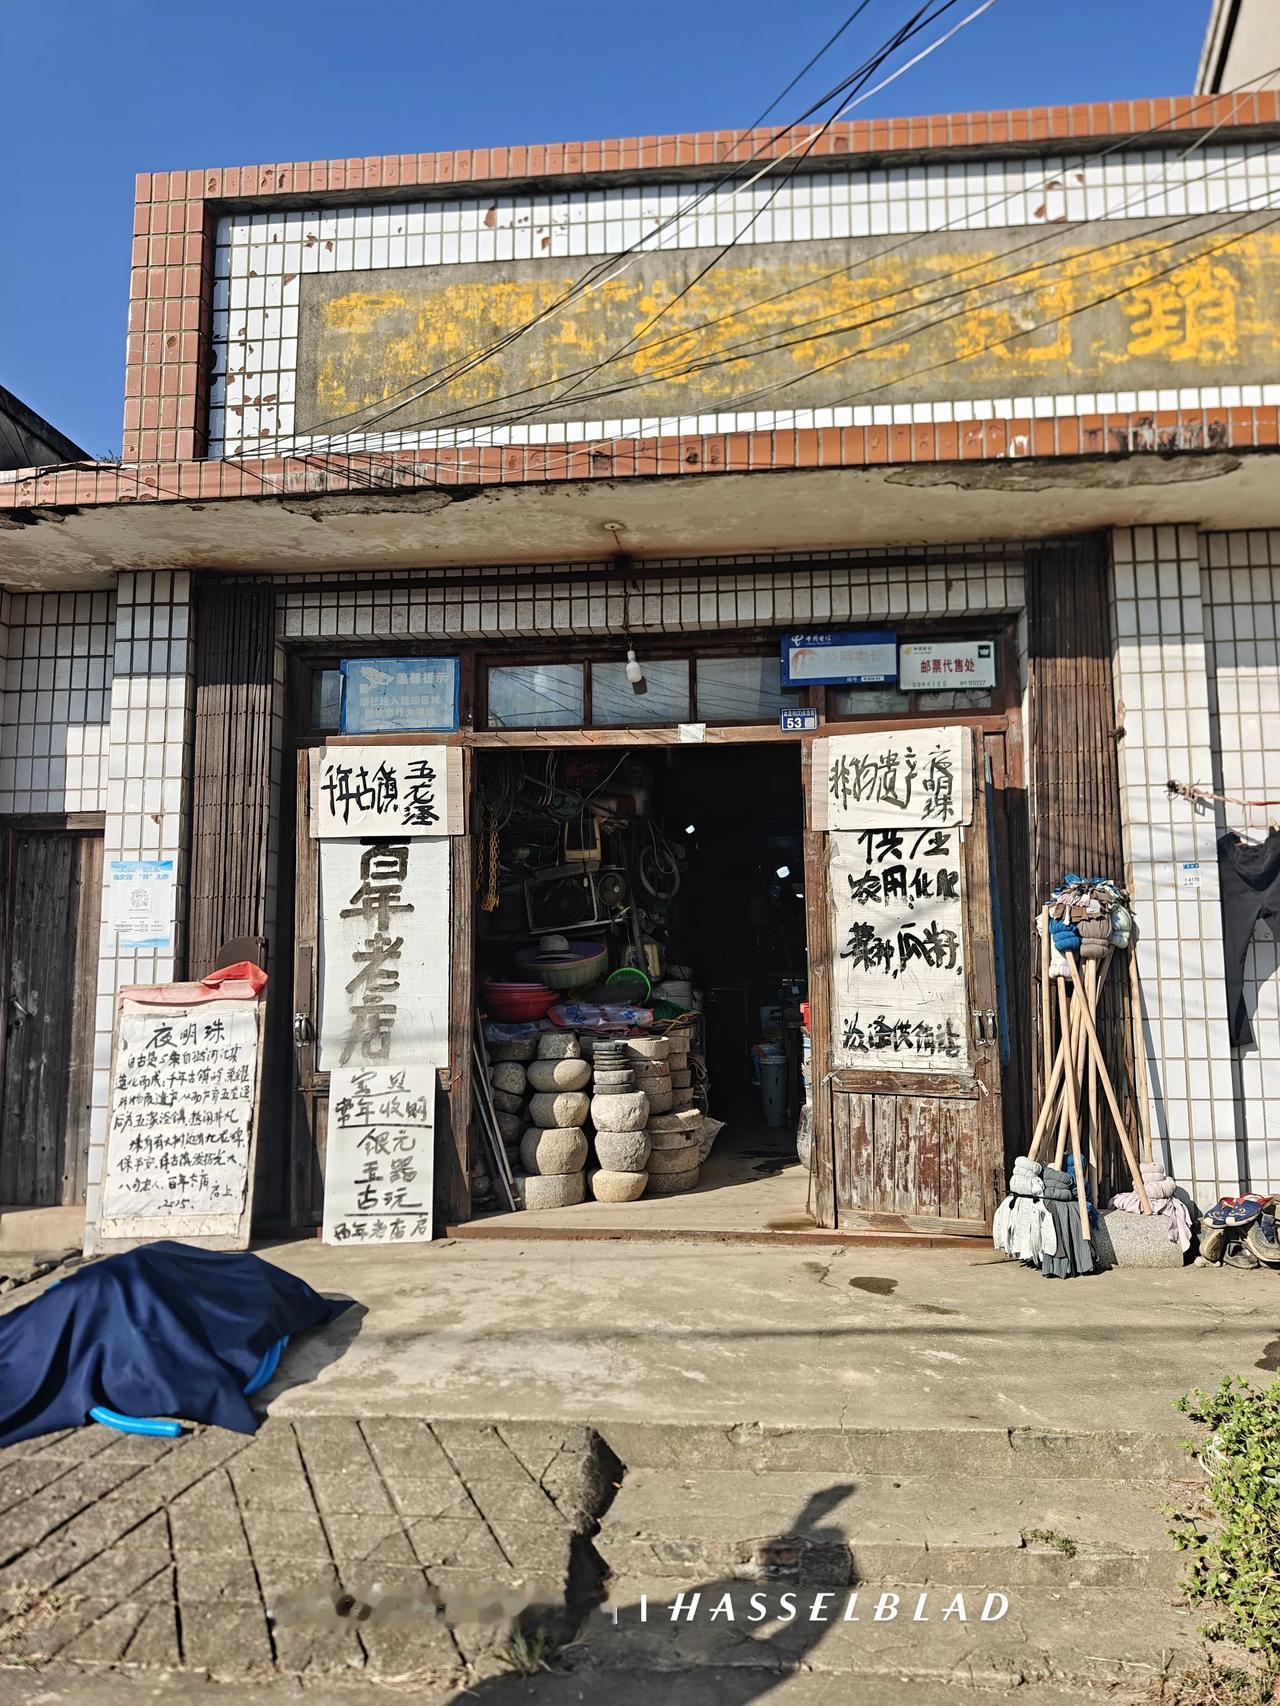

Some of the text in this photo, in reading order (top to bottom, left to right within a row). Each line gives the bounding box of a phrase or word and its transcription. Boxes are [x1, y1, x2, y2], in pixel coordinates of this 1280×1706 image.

[920, 658, 975, 673] 邮票代售处
[786, 717, 802, 729] 53
[340, 837, 415, 1068] 百年老店
[145, 1017, 225, 1049] 夜明珠
[357, 1184, 423, 1211] 古玩
